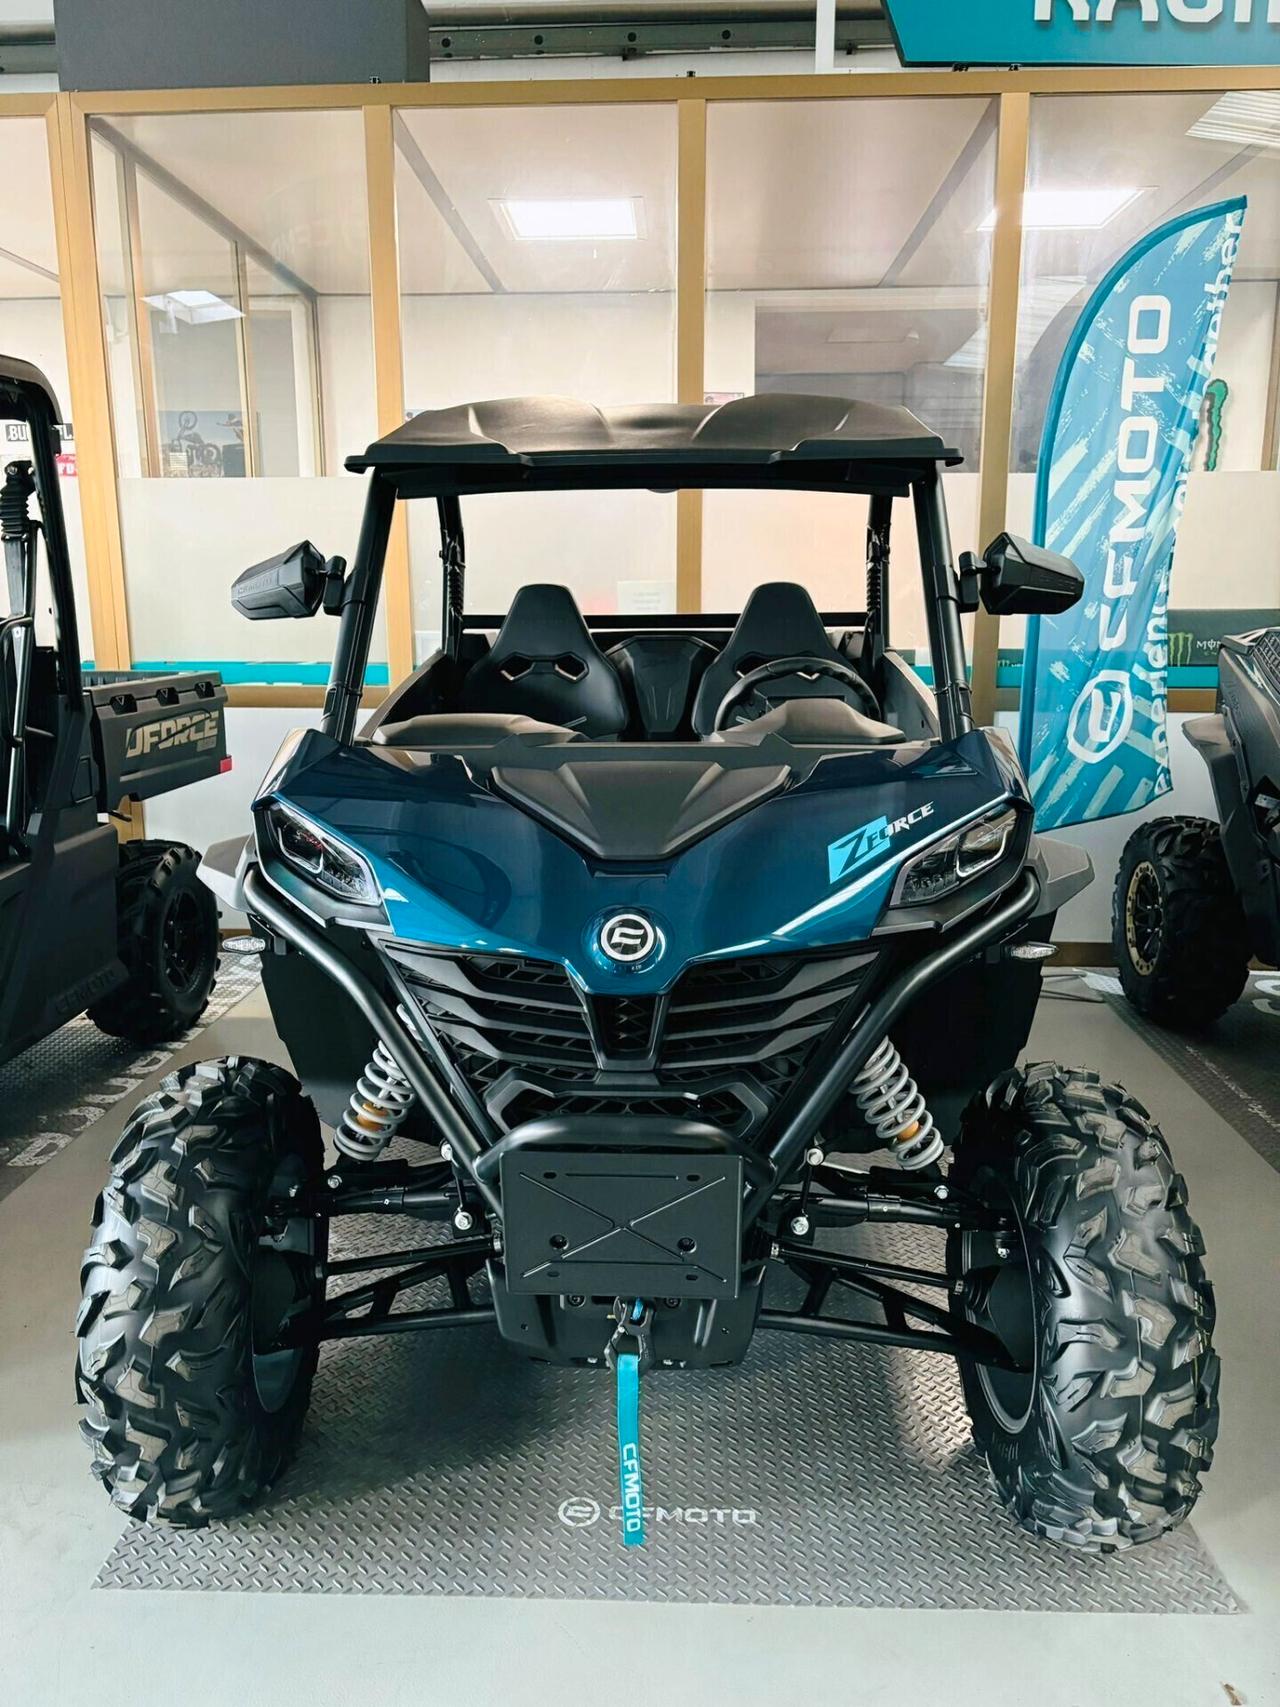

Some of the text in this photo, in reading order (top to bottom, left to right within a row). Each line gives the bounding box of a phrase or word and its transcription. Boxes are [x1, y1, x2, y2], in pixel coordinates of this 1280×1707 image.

[1099, 295, 1171, 651] CFMOTO
[126, 711, 219, 757] UFORCE
[623, 1443, 640, 1532] CFMOTO
